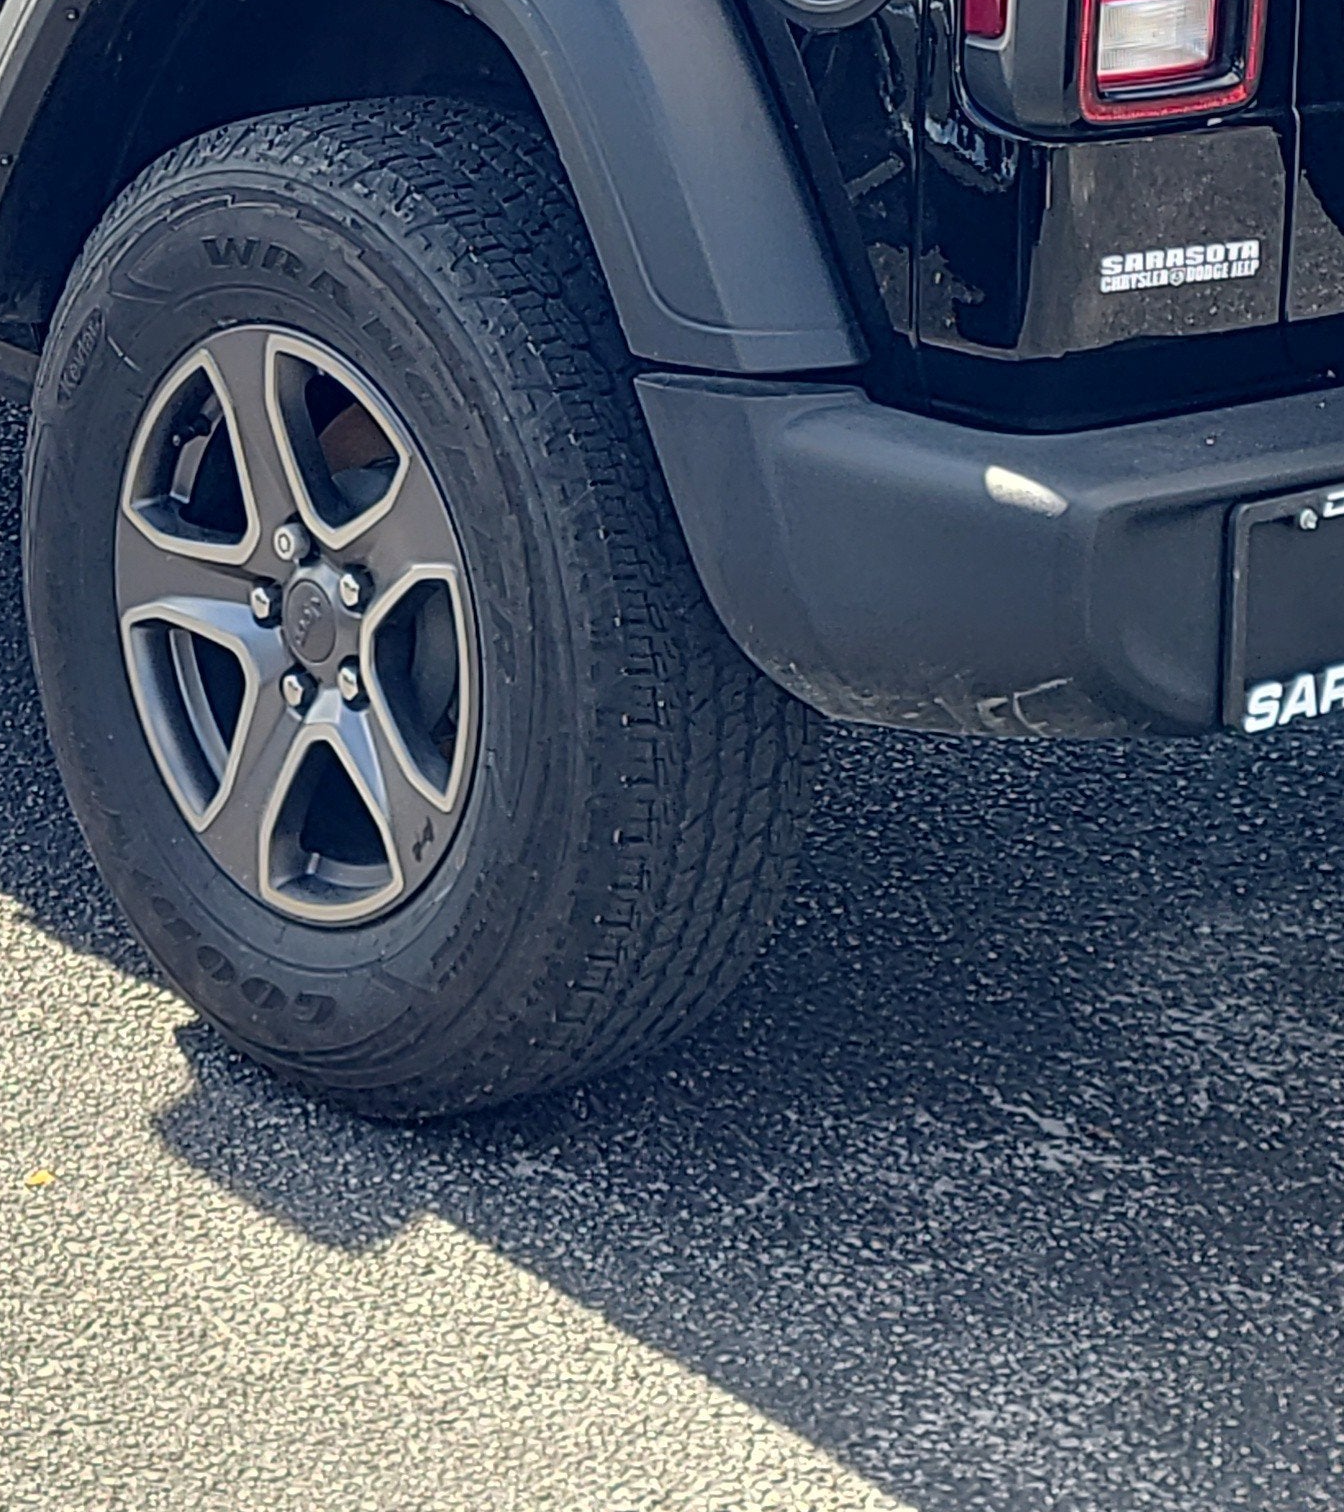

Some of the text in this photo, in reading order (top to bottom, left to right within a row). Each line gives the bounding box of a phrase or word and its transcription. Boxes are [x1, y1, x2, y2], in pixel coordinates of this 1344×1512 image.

[1100, 240, 1259, 276] SARASOTA
[1100, 268, 1169, 293] CHRYSLER
[1185, 261, 1229, 283] DODGE
